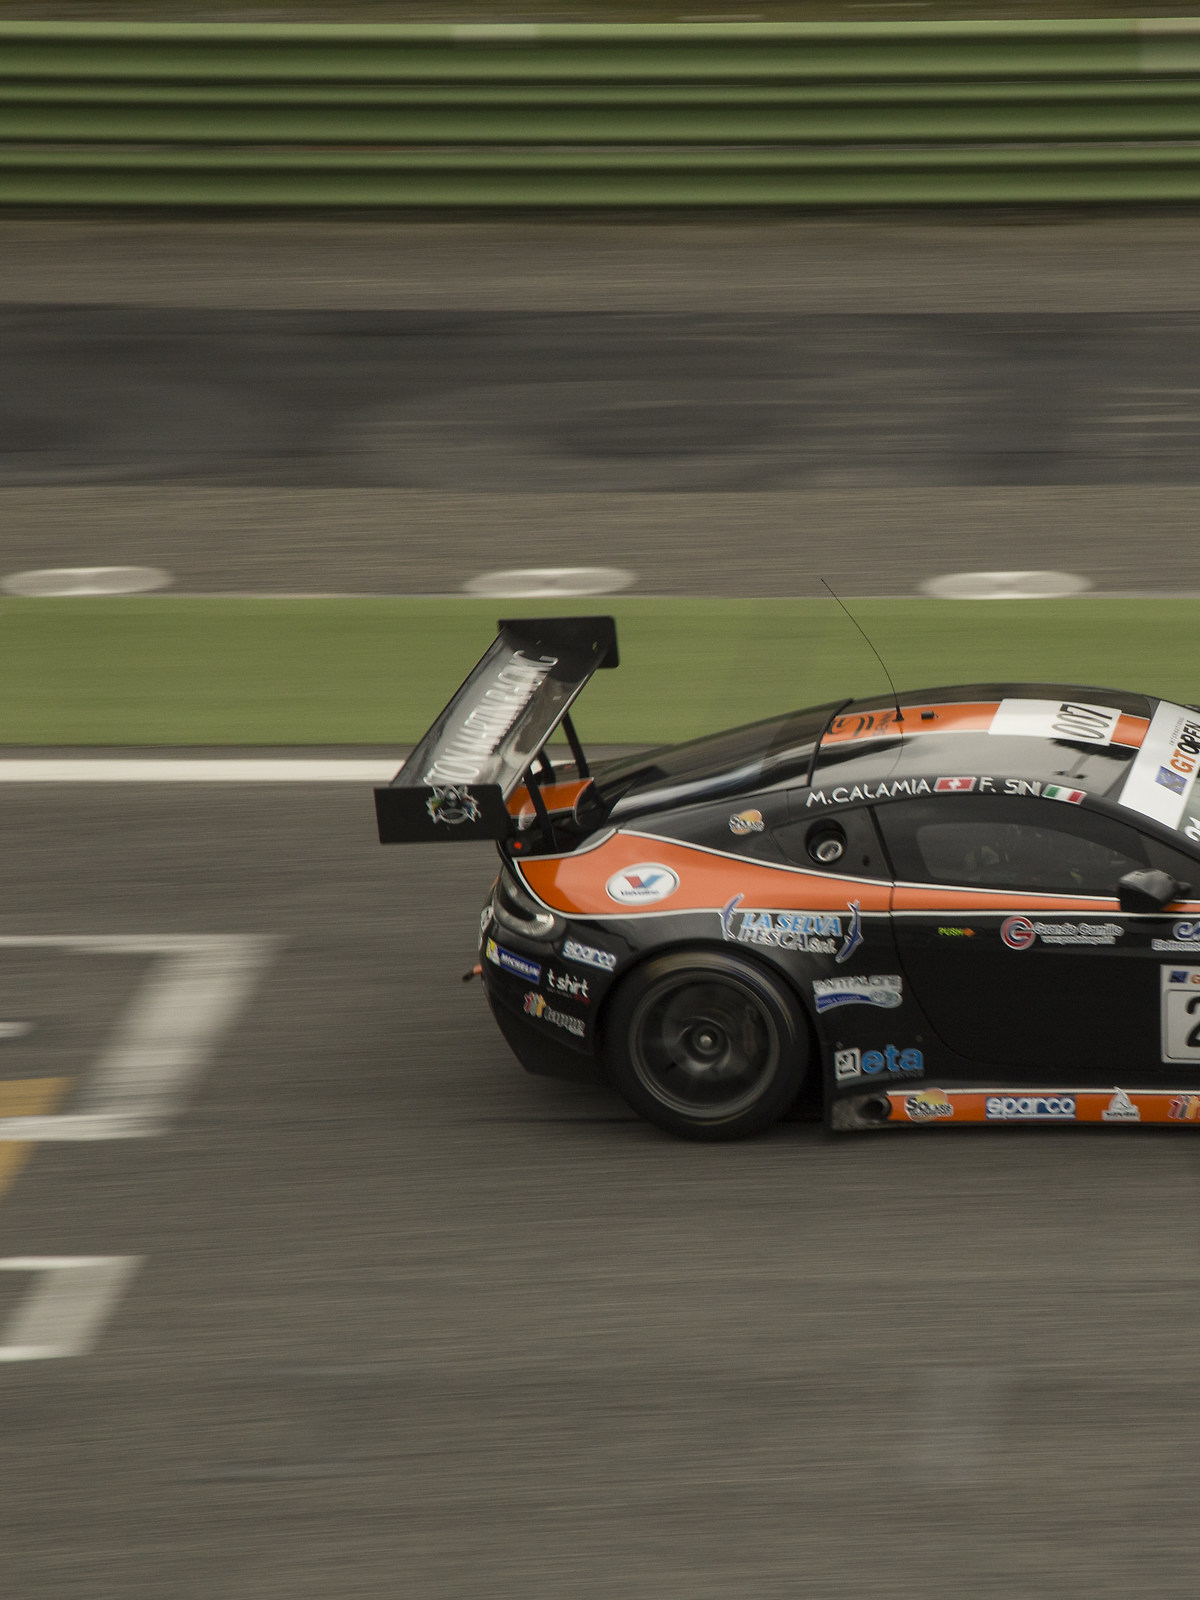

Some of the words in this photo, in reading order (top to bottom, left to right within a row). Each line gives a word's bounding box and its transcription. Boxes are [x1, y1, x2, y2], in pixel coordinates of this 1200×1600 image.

[1051, 702, 1113, 739] 007
[743, 912, 774, 932] LA
[775, 914, 842, 938] SELVA
[937, 926, 964, 937] PUSH
[562, 940, 617, 972] sparco
[985, 1096, 1076, 1120] sparco
